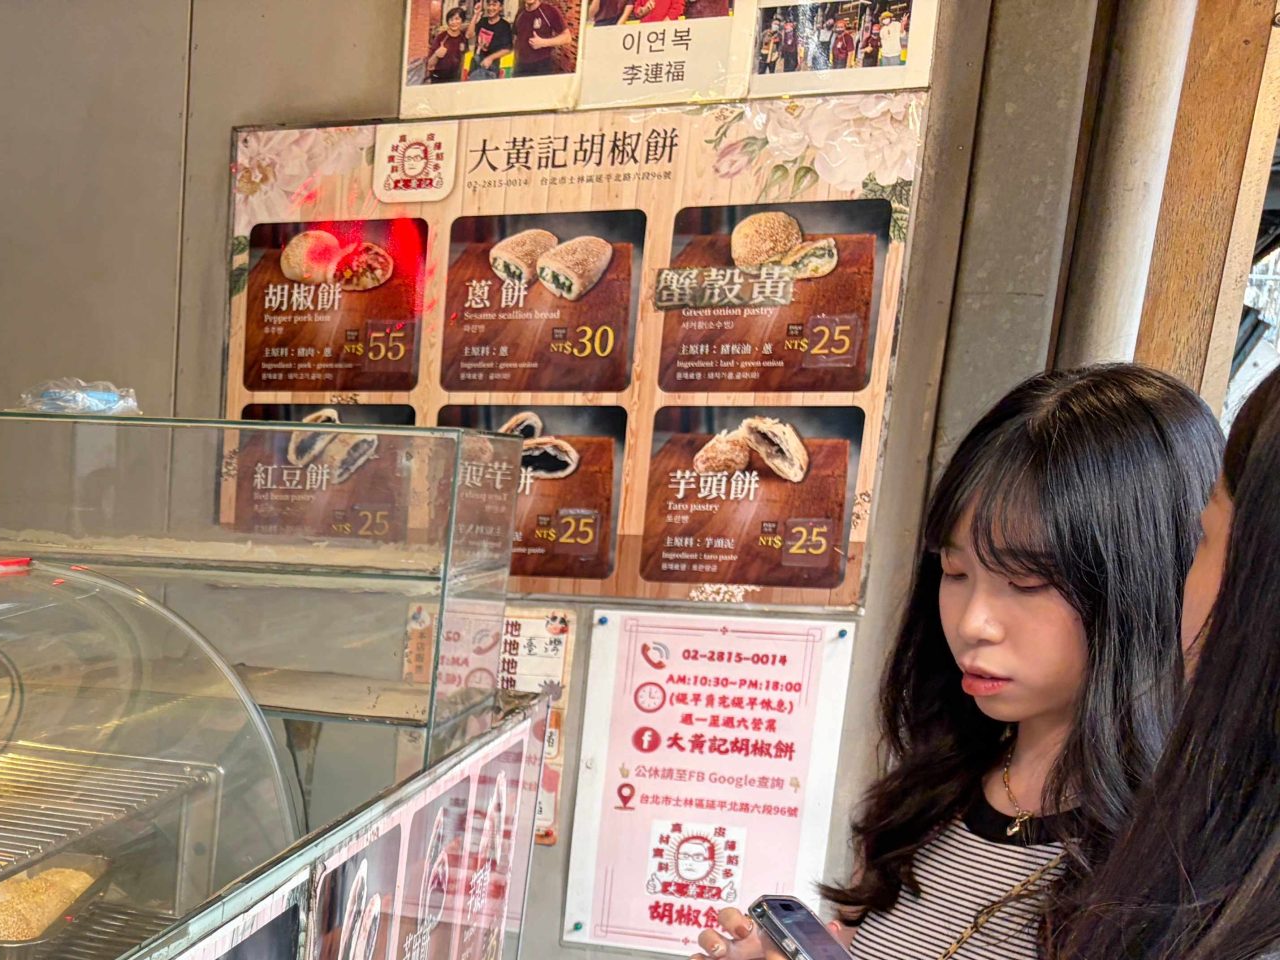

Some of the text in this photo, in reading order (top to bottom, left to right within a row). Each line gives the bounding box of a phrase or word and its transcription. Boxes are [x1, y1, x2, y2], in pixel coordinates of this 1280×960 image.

[622, 27, 692, 54] 이연복
[622, 60, 686, 85] 李連福
[468, 127, 679, 175] 大黃記胡椒餅
[264, 282, 342, 311] 胡椒餅
[656, 265, 793, 306] 蟹殼黃
[264, 313, 331, 325] Pepper pork bun
[464, 310, 561, 320] Sesame scallion bread
[682, 307, 775, 318] Green onion pastry
[344, 344, 365, 356] NT$
[368, 331, 406, 361] 55
[550, 342, 572, 355] NT$
[572, 325, 615, 358] 30
[784, 338, 808, 352] NT$
[810, 325, 852, 354] 25
[253, 463, 331, 491] 紅豆餅
[668, 469, 760, 500] 芋頭餅
[667, 501, 720, 513] Taro pastry
[358, 510, 390, 536] 25
[535, 528, 557, 542] NT$
[559, 516, 595, 545] 25
[758, 525, 828, 556] NT$ 25
[504, 619, 521, 637] 地
[502, 638, 520, 656] 地
[682, 649, 788, 666] 02-2815-0014
[501, 657, 518, 675] 地
[666, 674, 802, 692] AM:10:30~PM:18:00
[667, 732, 796, 761] 大黃記胡椒餅
[634, 764, 785, 790] 公休請至FB Google查詢
